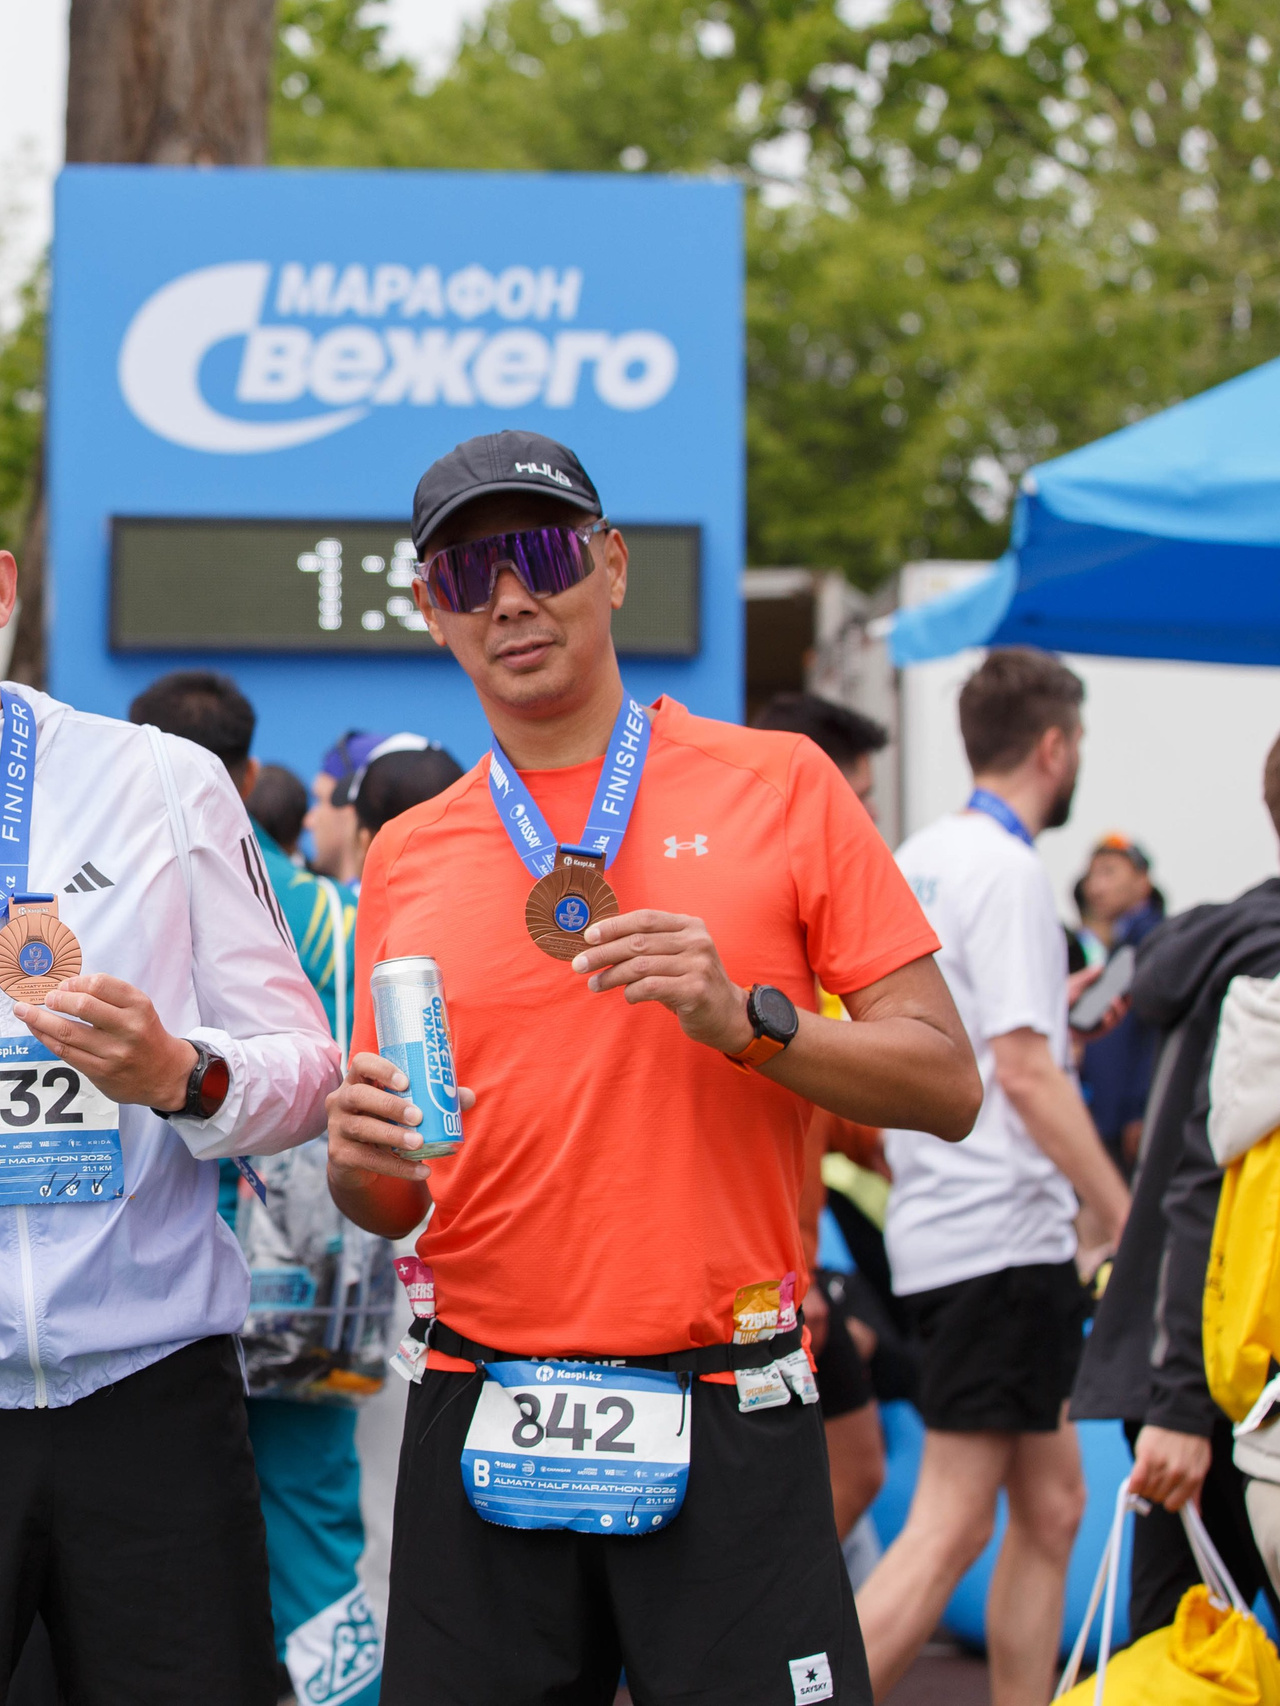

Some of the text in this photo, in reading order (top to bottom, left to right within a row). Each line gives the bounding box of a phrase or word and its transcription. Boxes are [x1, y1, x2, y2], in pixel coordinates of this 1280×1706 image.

[276, 262, 583, 320] МАРАФОН
[515, 461, 573, 488] HUUB
[1, 702, 29, 842] FINISHER
[602, 699, 645, 816] FINISHER
[517, 814, 543, 848] TASSAY
[422, 1006, 440, 1081] КРУЖКА
[8, 1156, 78, 1165] MARATHON
[80, 1154, 112, 1162] 2026
[557, 1369, 603, 1381] Kaspi.kz
[511, 1393, 635, 1454] 842
[473, 1458, 490, 1488] B
[493, 1477, 677, 1494] ALMATY HALF MARATHON 2026
[800, 1682, 827, 1695] SAYSKY
